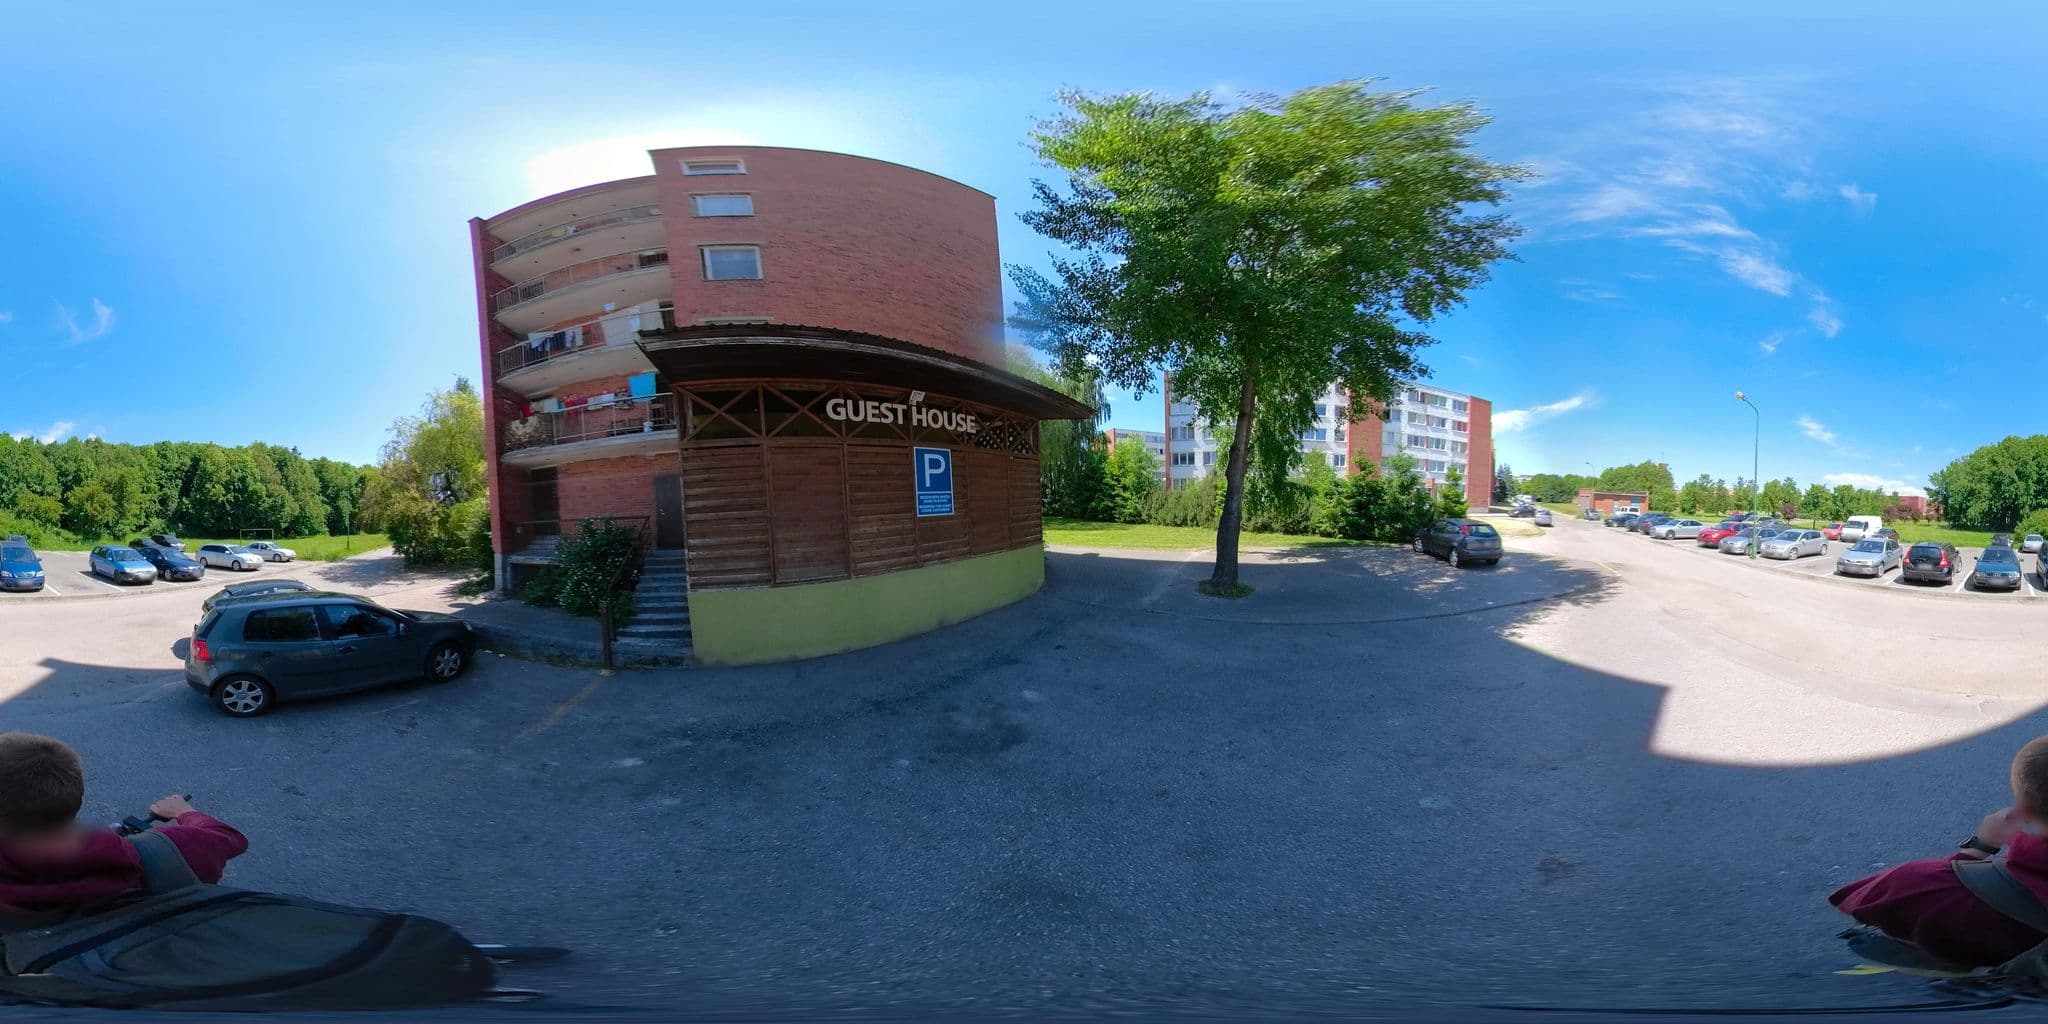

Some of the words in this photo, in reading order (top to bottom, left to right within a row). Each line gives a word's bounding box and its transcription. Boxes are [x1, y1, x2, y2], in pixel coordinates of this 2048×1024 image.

[826, 399, 907, 425] GUEST
[912, 406, 977, 434] HOUSE
[924, 453, 946, 487] P
